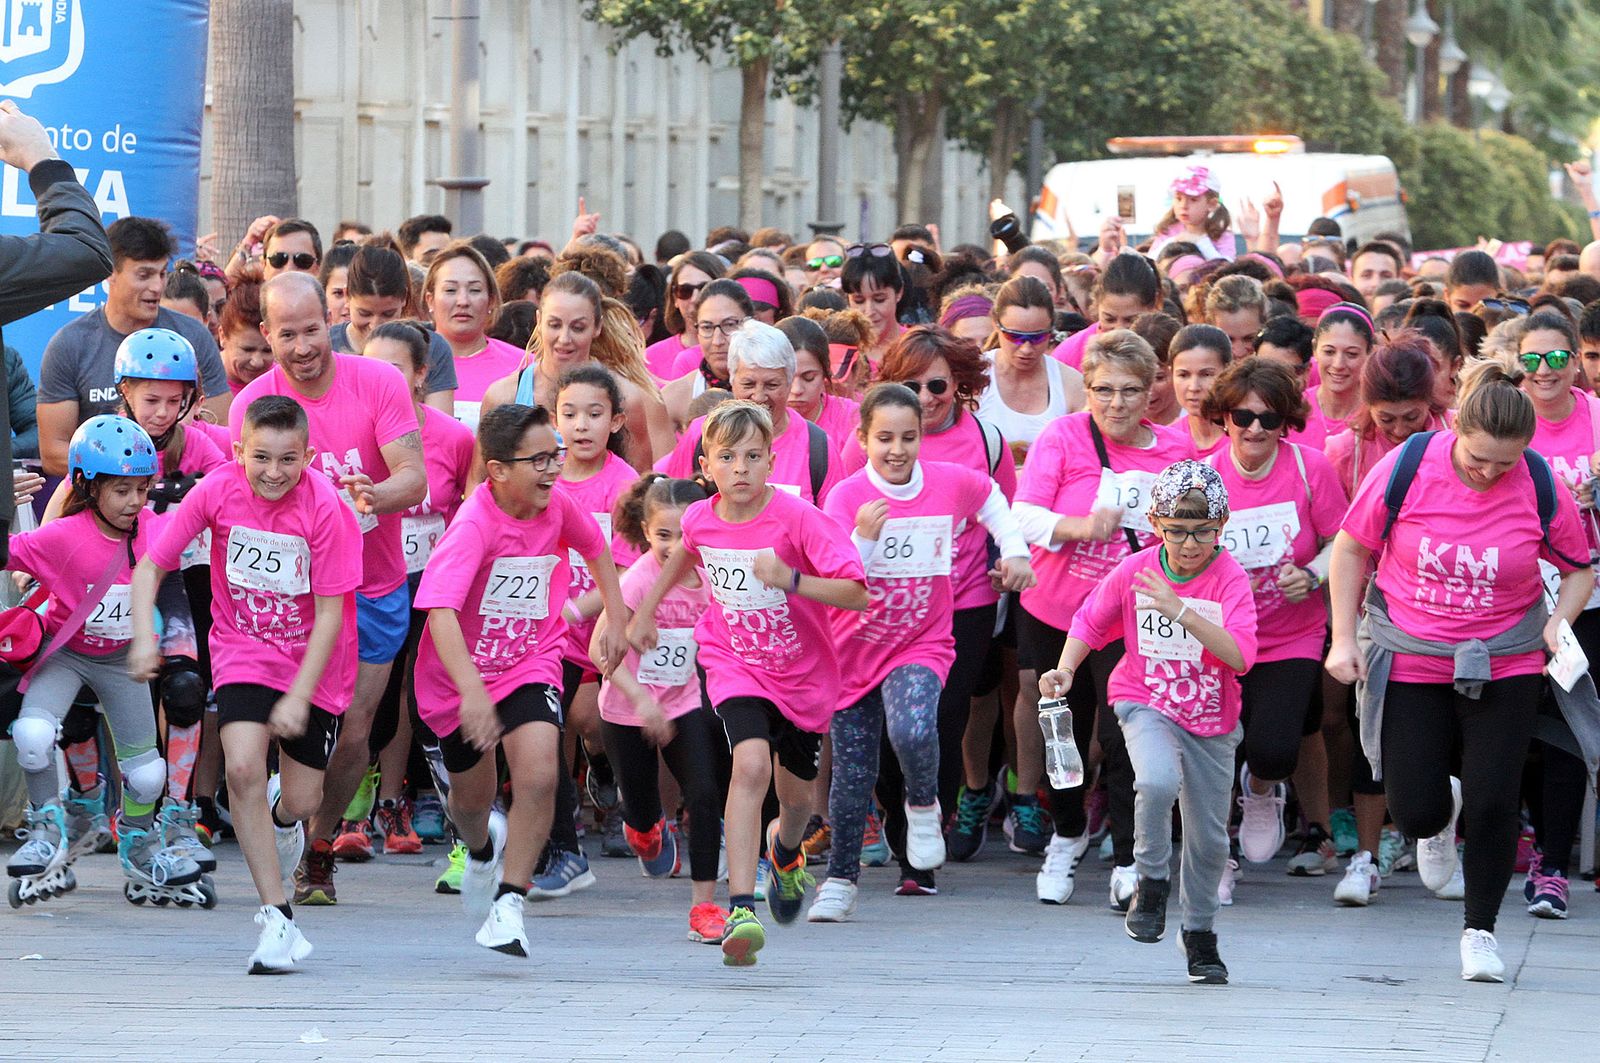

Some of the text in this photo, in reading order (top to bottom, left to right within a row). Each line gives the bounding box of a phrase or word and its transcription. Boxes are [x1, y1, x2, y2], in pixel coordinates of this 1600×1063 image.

[55, 0, 67, 24] DIA
[102, 124, 137, 154] de
[310, 447, 364, 483] M
[1545, 455, 1591, 486] M
[884, 535, 914, 559] 86
[1223, 524, 1271, 552] 512
[232, 541, 281, 573] 725
[1417, 536, 1499, 580] KM
[490, 575, 539, 599] 722
[708, 563, 748, 591] 322
[722, 604, 789, 633] POR
[731, 625, 797, 652] ELLAS
[654, 646, 687, 668] 38
